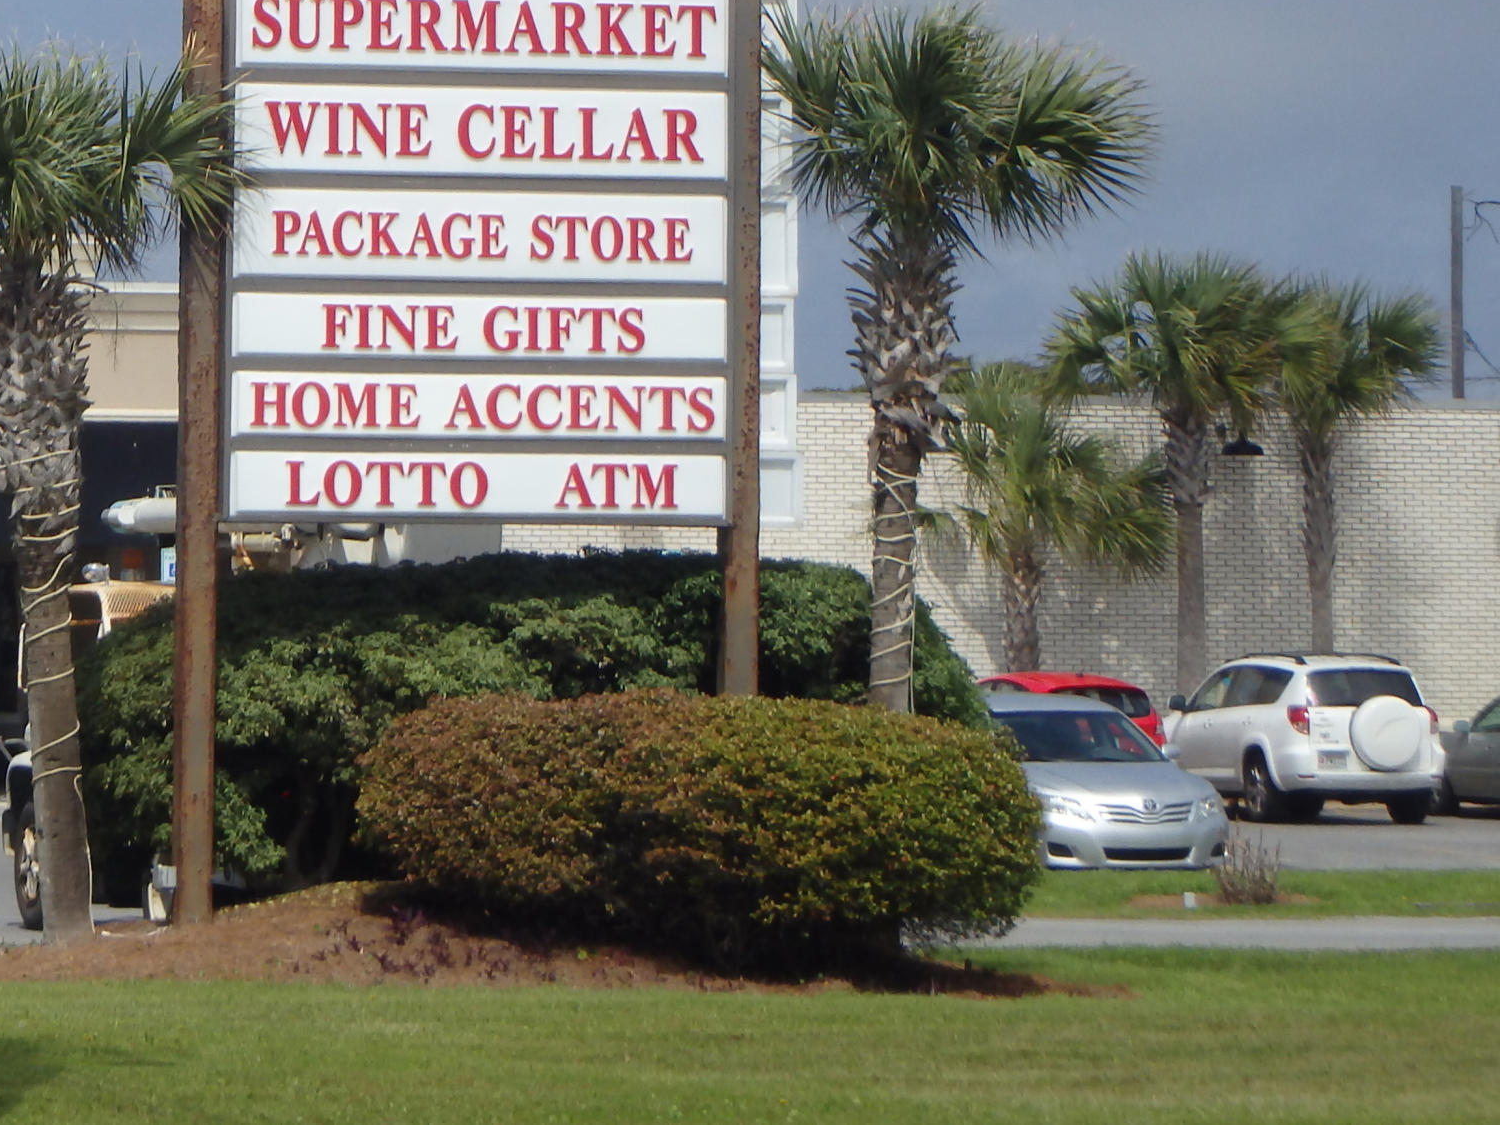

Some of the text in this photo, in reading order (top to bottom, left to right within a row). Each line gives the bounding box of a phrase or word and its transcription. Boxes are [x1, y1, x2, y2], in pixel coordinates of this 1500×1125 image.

[265, 101, 704, 164] WINE CELLAR
[272, 210, 694, 262] PACKAGE STORE
[322, 304, 646, 353] FINE GIFTS
[250, 382, 716, 433] HOME ACCENTS
[286, 460, 678, 509] LOTTO ATM
